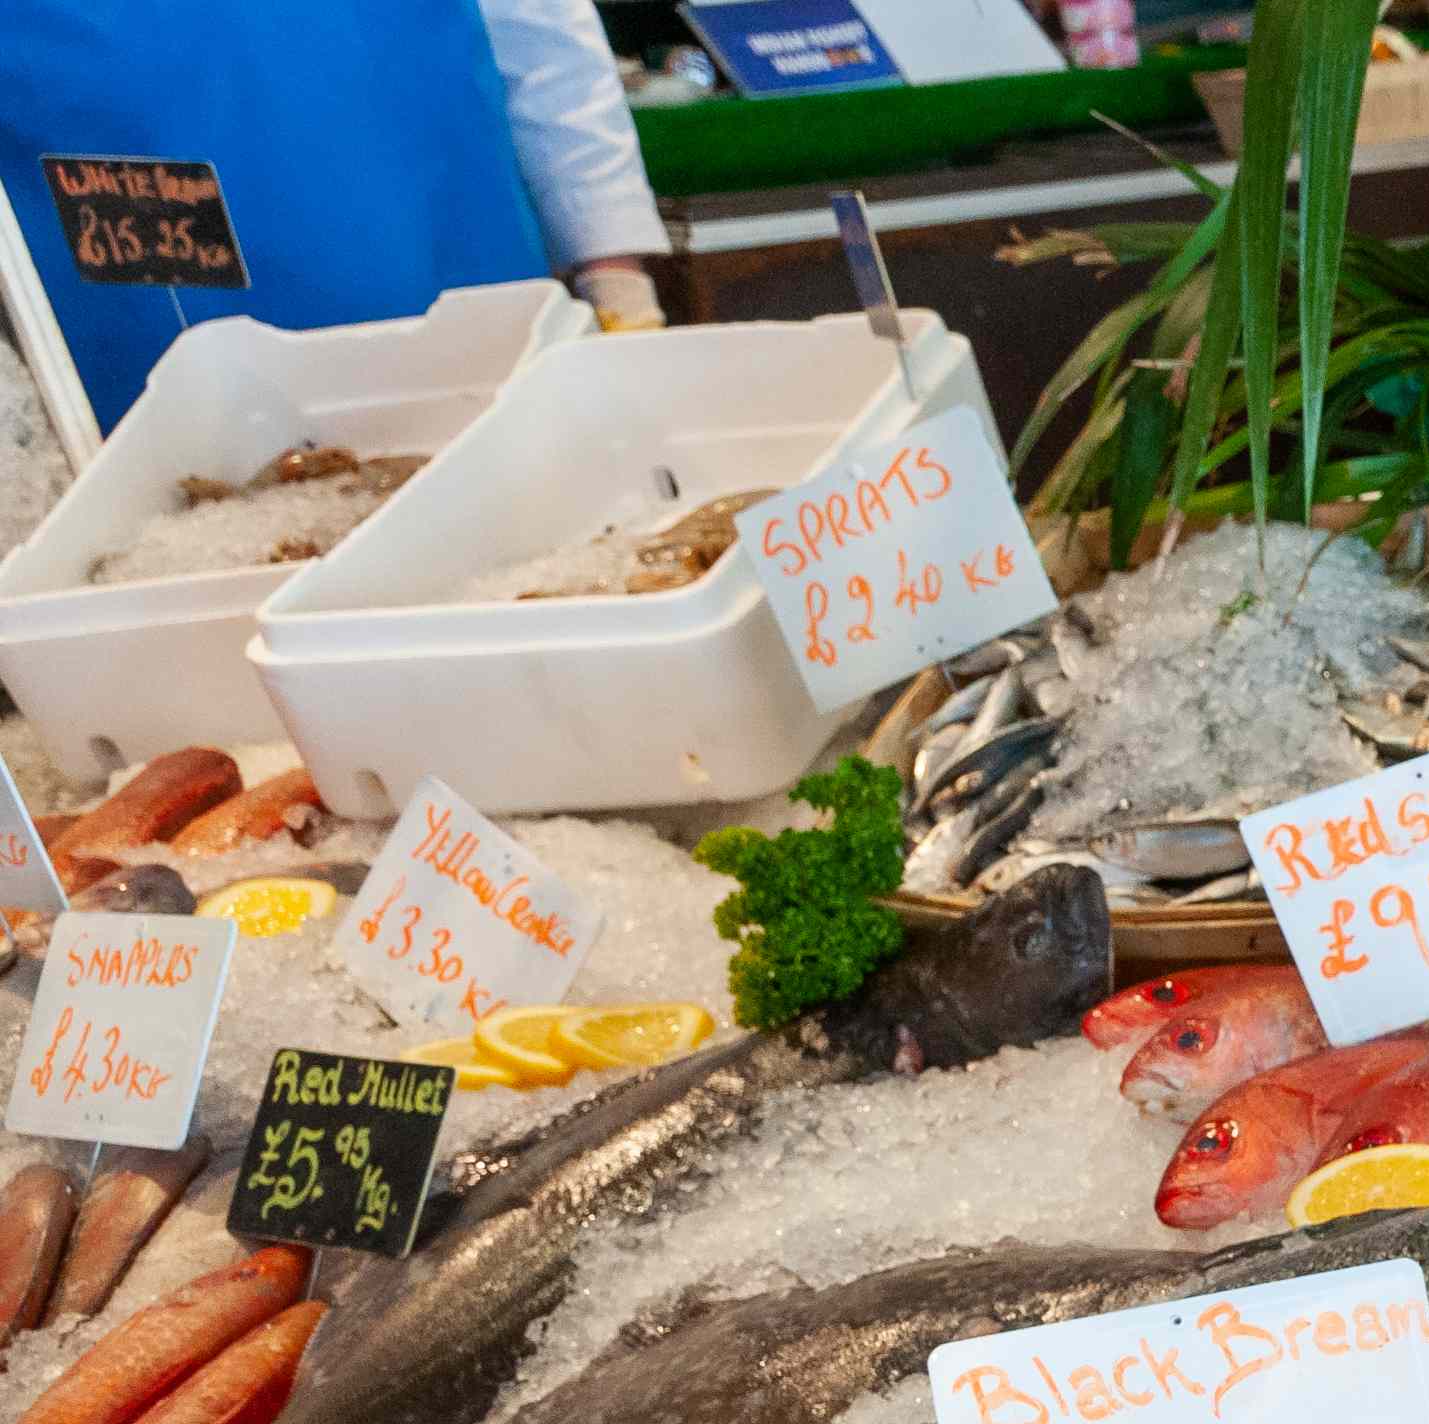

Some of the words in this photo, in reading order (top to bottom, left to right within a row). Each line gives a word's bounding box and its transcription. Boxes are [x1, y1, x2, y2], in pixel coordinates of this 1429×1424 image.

[761, 447, 953, 576] SPRATS
[272, 1050, 345, 1107] Red
[347, 1060, 448, 1117] Mullet
